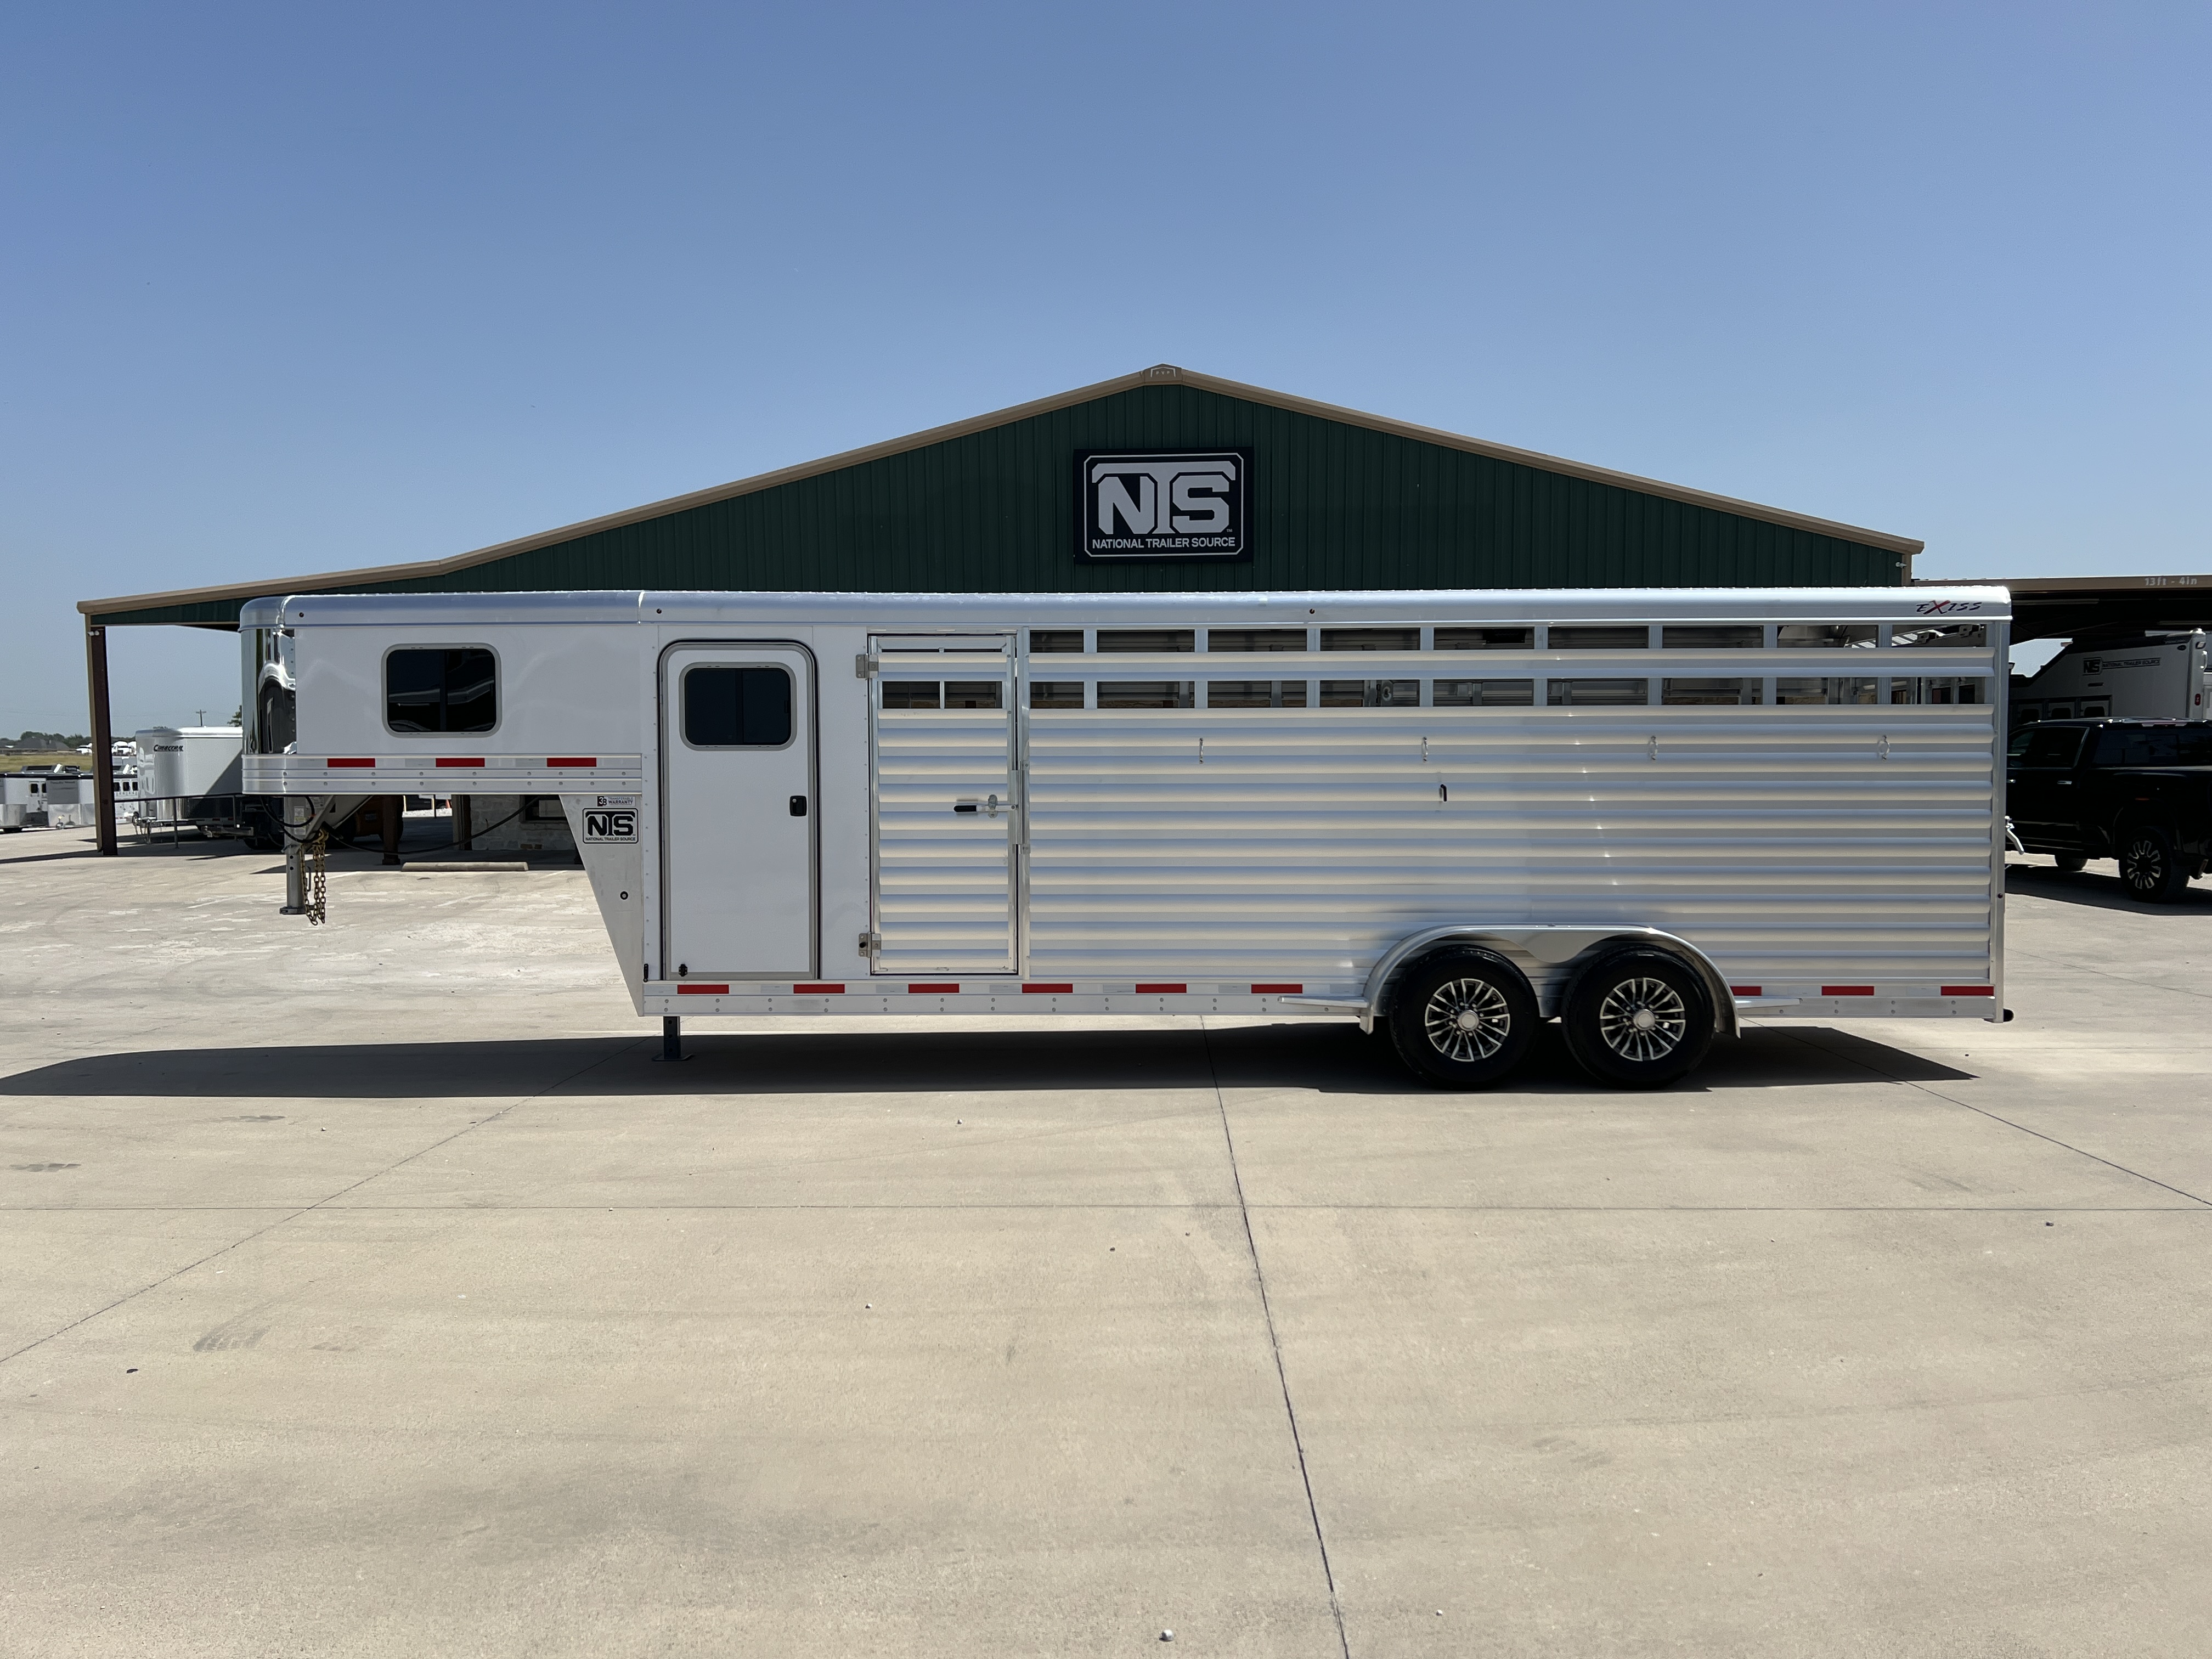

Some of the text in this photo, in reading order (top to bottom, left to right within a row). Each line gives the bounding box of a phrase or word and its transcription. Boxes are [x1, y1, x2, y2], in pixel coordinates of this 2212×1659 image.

[1092, 461, 1235, 534] NTS
[1092, 537, 1235, 549] NATIONAL TRAILER SOURCE
[2145, 577, 2166, 585] 13ft
[2179, 577, 2197, 585] 4in
[585, 811, 635, 836] NTS
